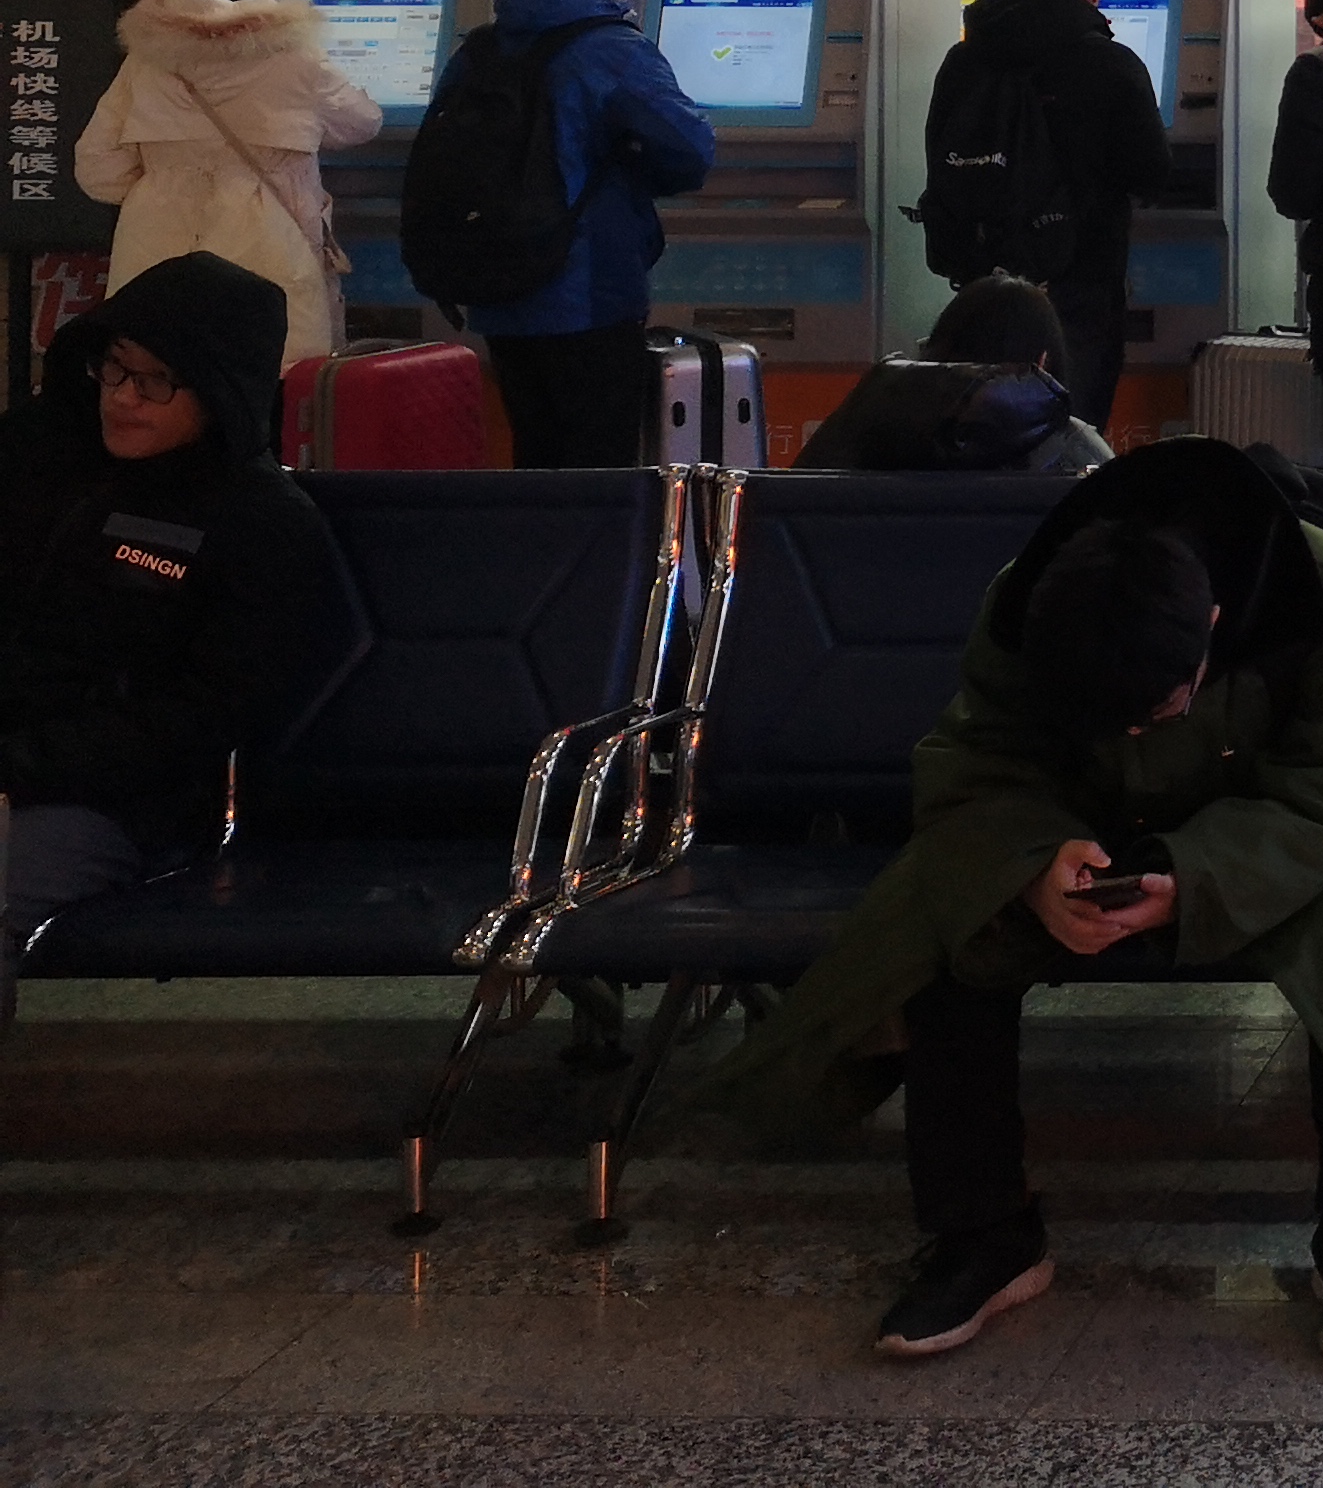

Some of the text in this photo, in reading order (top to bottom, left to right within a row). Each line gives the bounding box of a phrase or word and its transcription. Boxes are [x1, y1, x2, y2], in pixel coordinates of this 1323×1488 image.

[8, 20, 61, 202] 机场快线等候区
[115, 543, 188, 580] DSINGN
